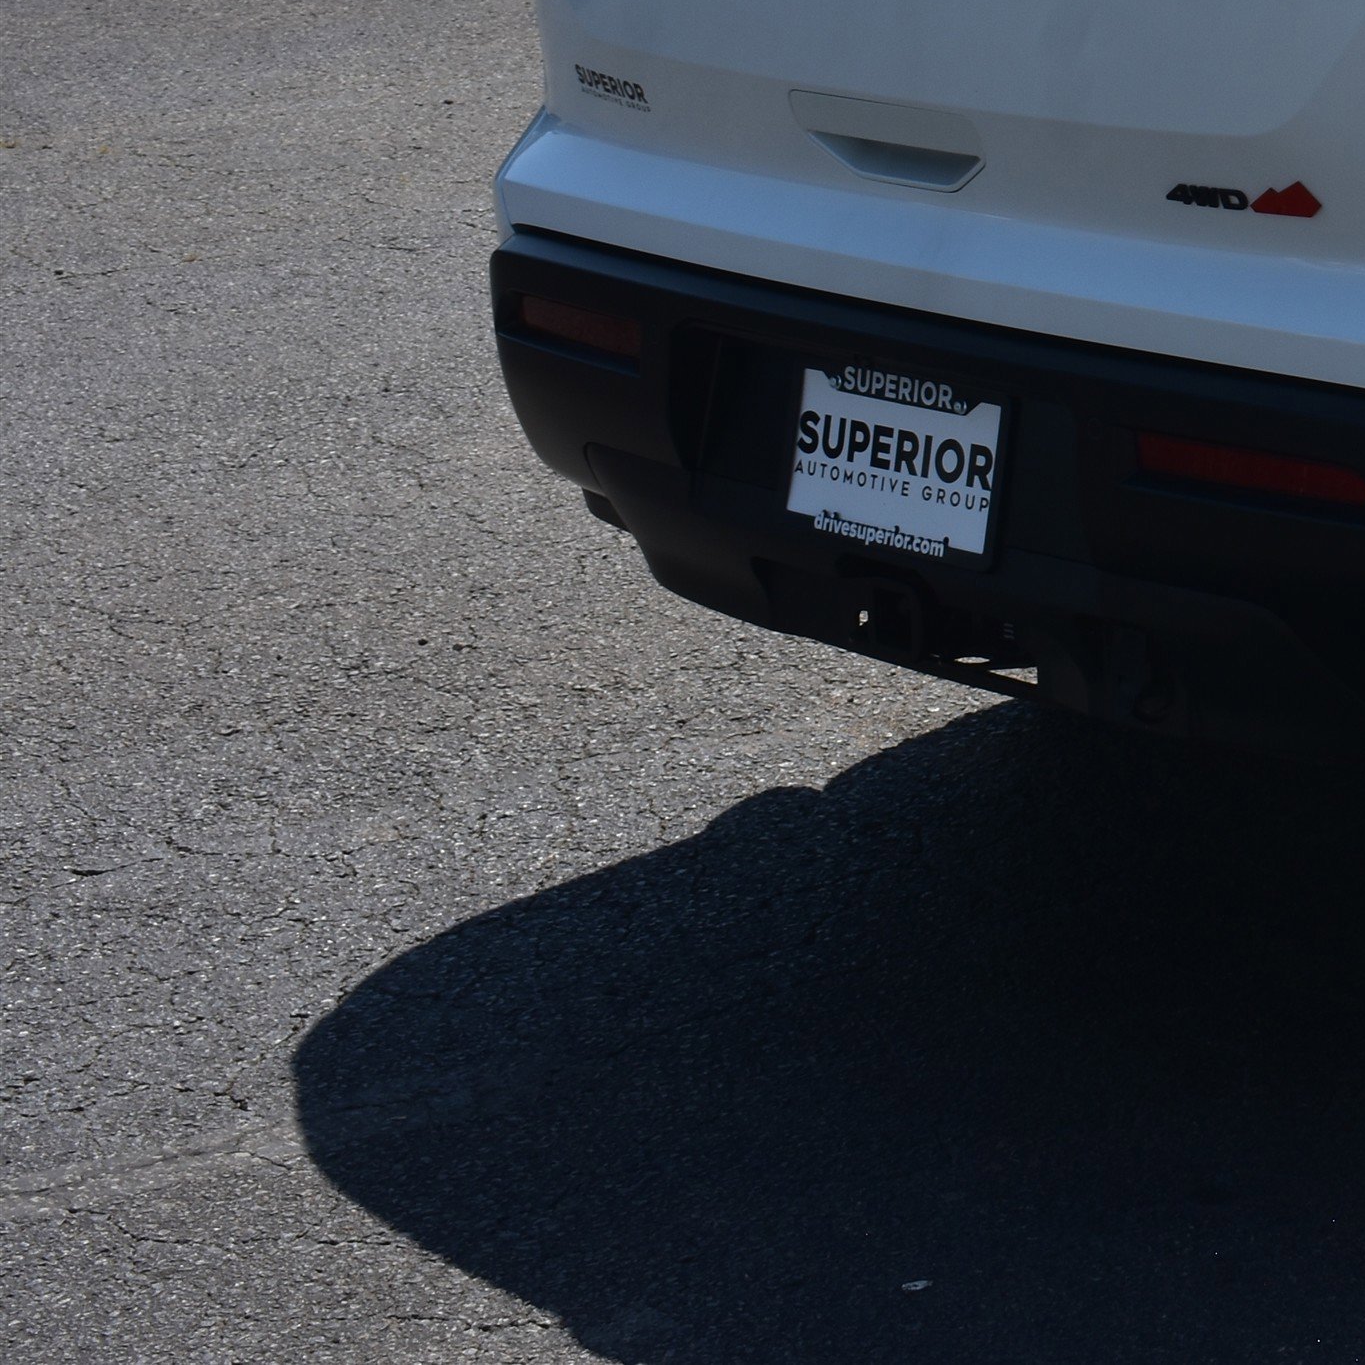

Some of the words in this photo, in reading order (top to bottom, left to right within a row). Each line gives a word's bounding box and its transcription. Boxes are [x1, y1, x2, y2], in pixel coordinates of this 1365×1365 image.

[575, 64, 648, 103] SUPERIOR
[1166, 183, 1249, 210] 4WD
[844, 365, 953, 410] SUPERIOR
[797, 410, 994, 491] SUPERIOR
[795, 459, 910, 497] AUTOMOTIVE
[922, 485, 990, 513] GROUP
[814, 511, 945, 557] drivesuperior.com
